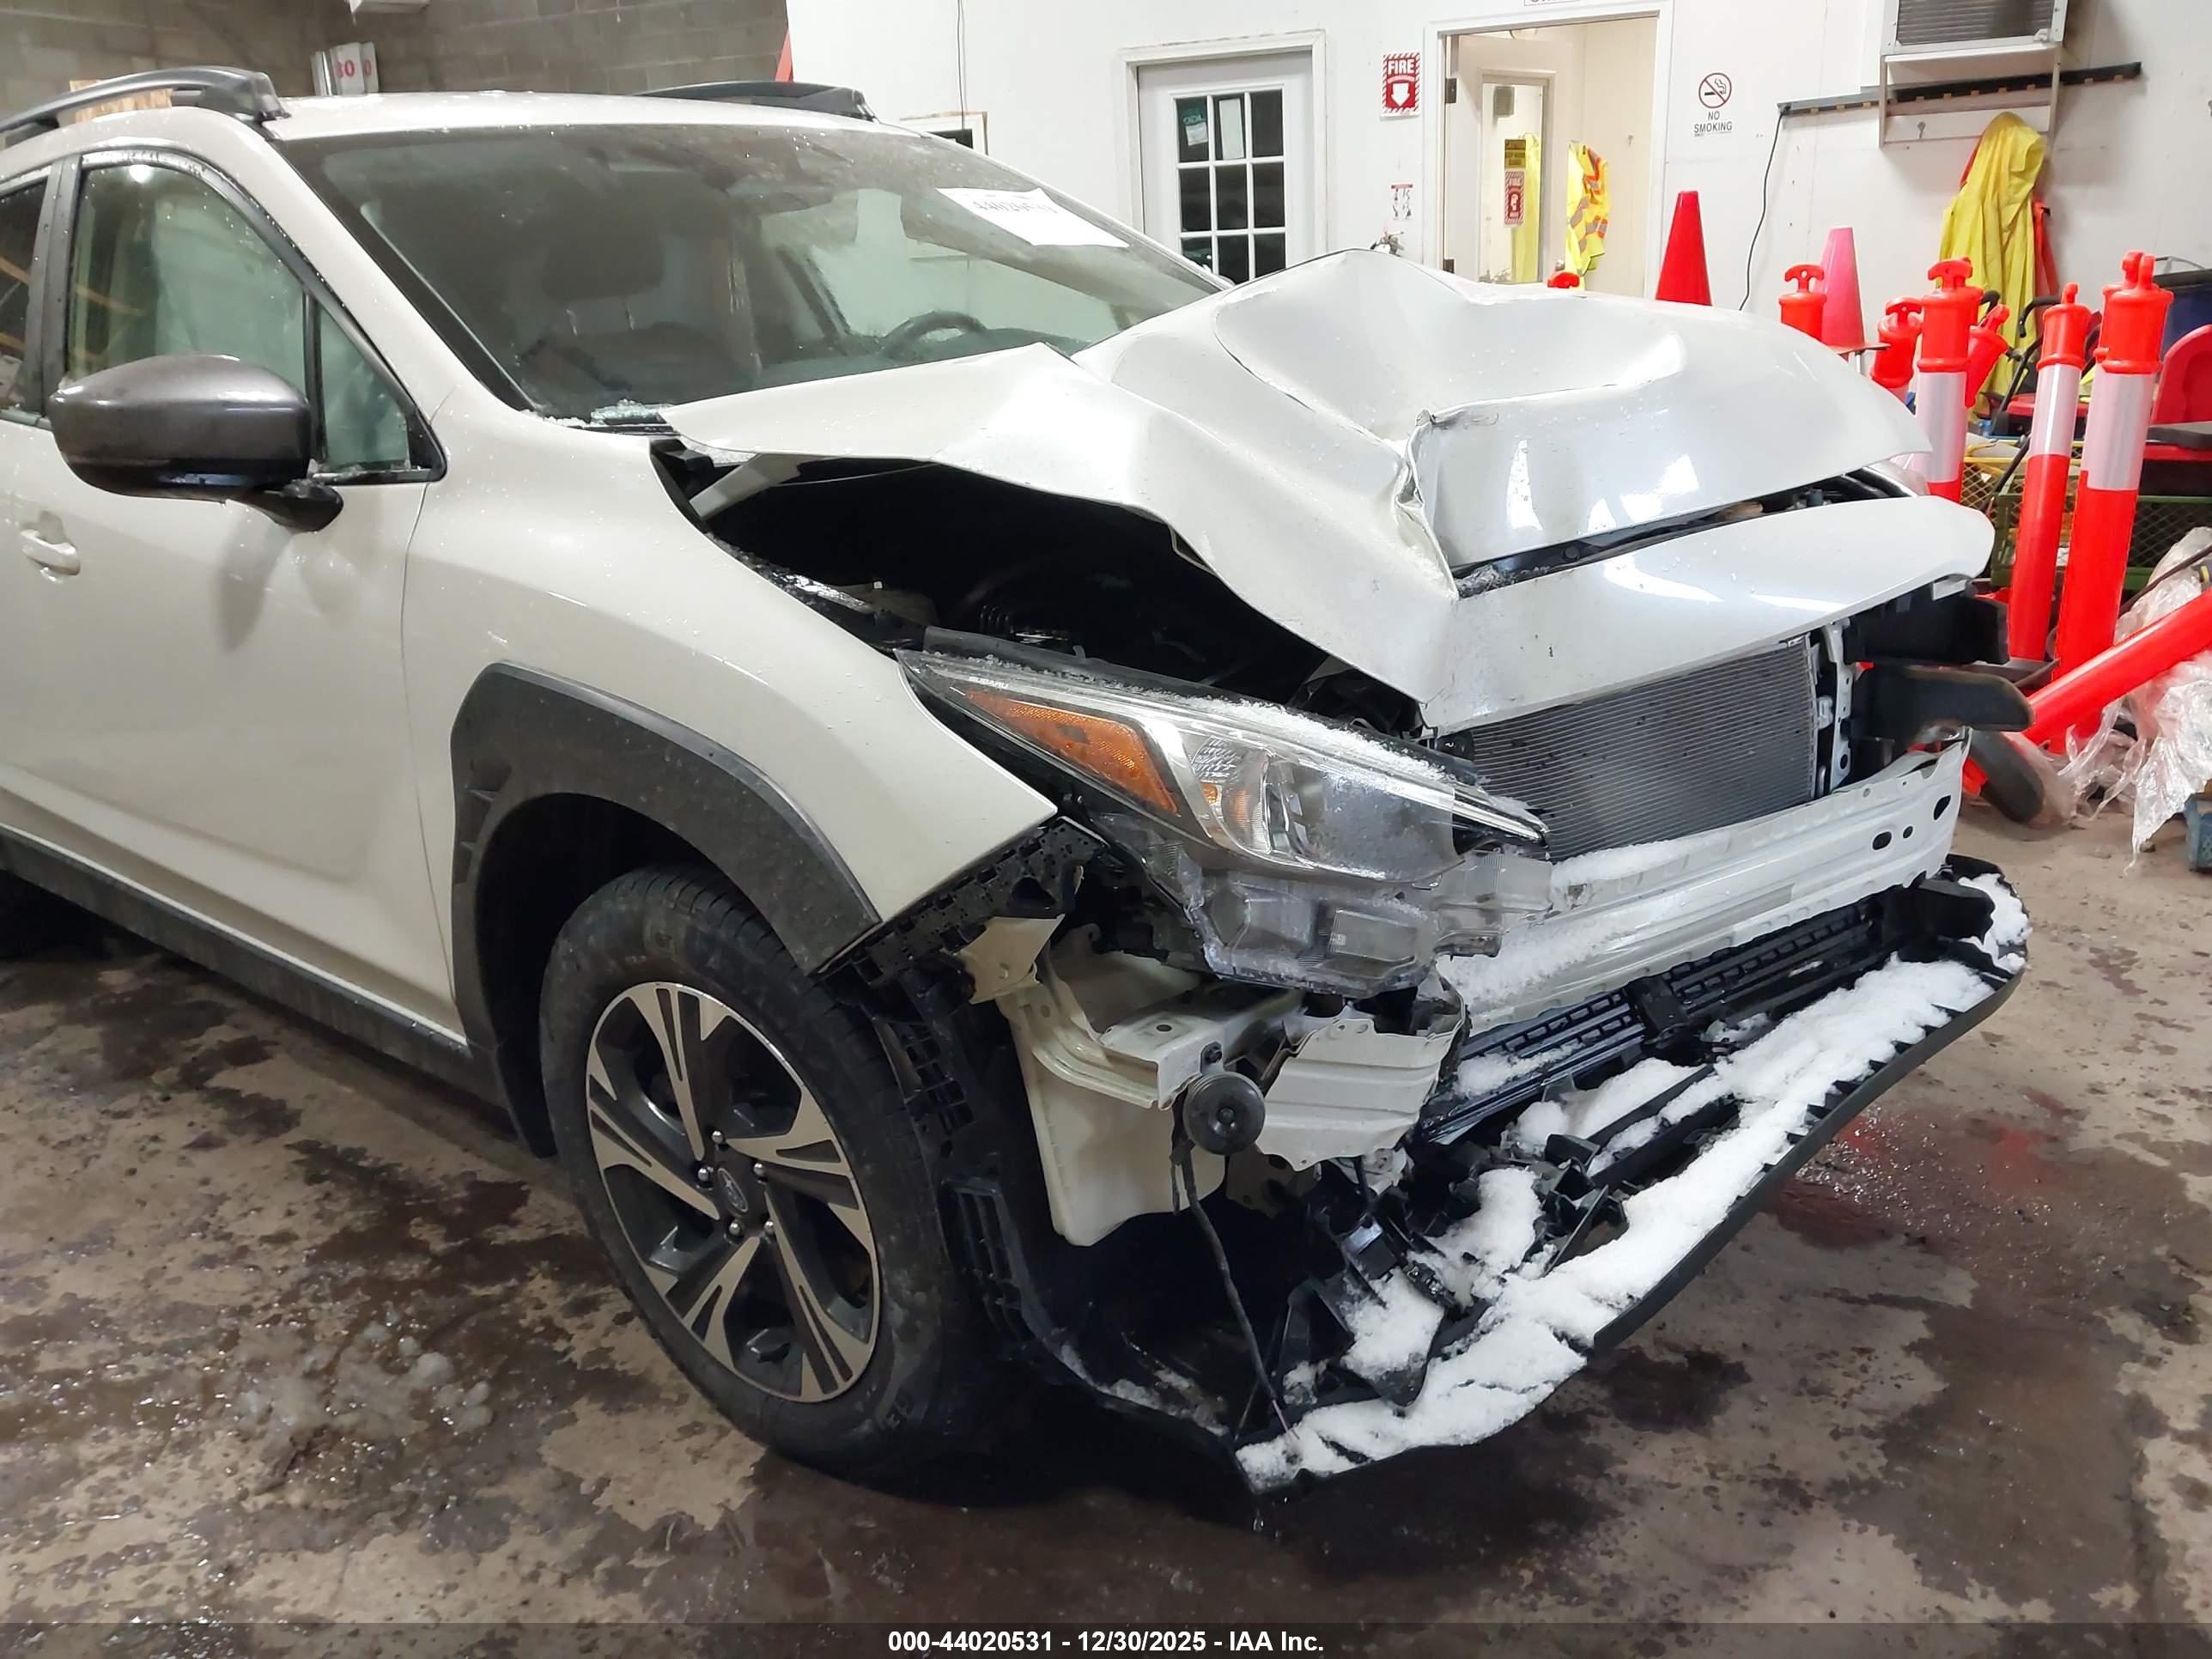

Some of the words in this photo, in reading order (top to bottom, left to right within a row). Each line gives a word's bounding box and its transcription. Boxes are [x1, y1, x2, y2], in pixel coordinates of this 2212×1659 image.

[1387, 58, 1415, 75] FIRE
[1708, 111, 1721, 120] NO
[1694, 121, 1733, 133] SMOKING
[969, 676, 1009, 690] SUBARU
